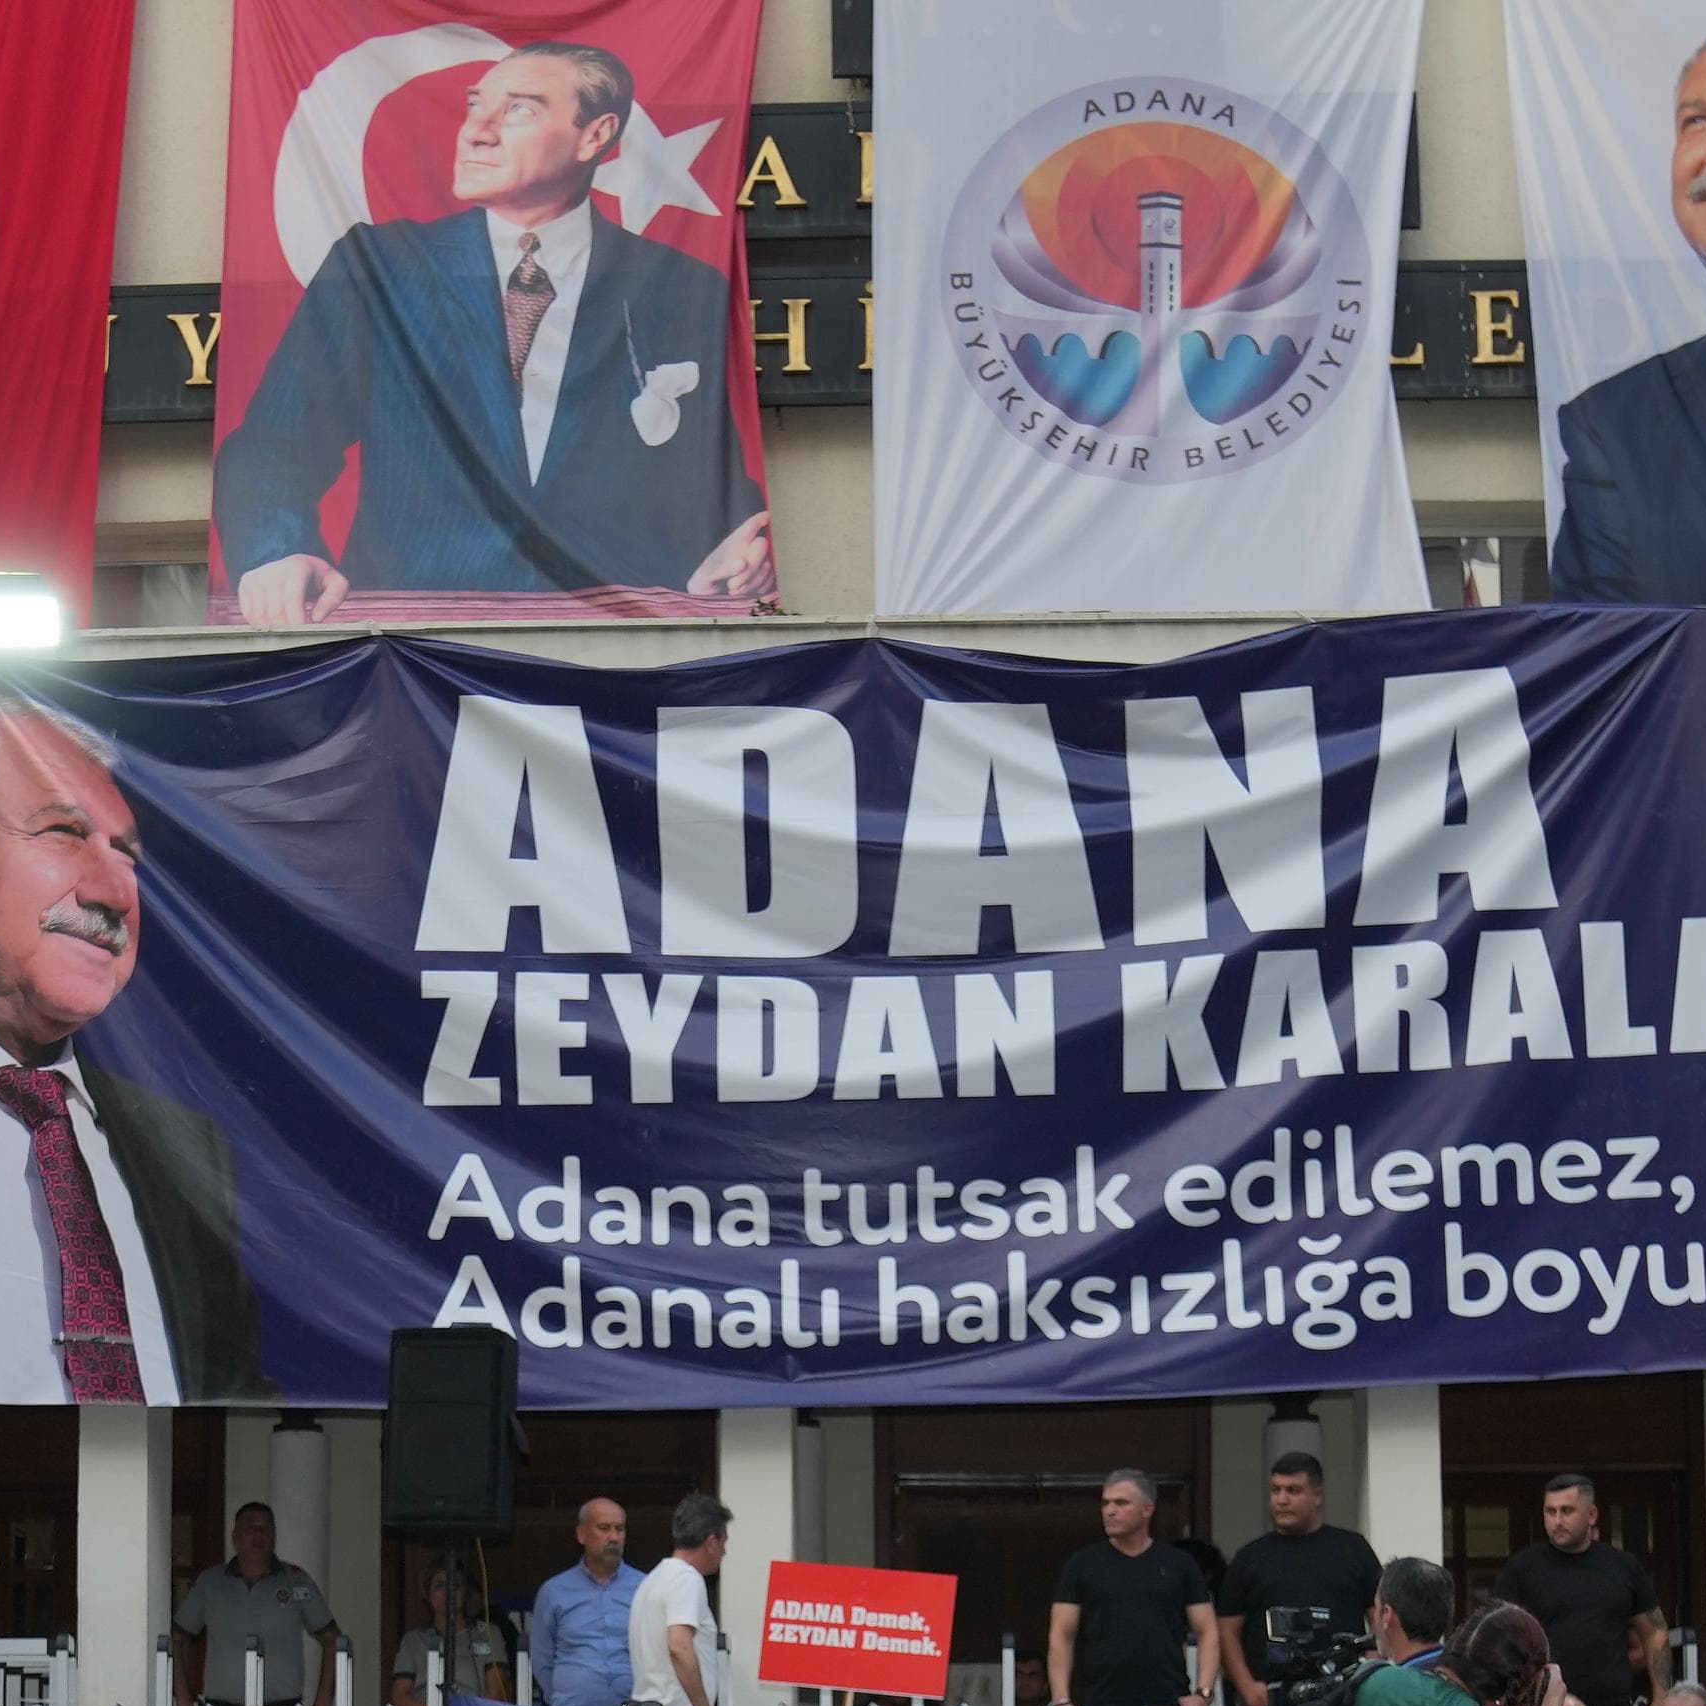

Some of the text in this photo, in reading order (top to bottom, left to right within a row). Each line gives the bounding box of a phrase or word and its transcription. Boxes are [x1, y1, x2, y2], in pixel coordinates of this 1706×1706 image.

[1083, 88, 1237, 127] ADANA
[414, 666, 1560, 958] ADANA
[421, 971, 1063, 1107] ZEYDAN
[428, 1124, 1694, 1248] Adana tutsak edilemez,
[432, 1254, 840, 1349] Adanalı
[878, 1235, 1413, 1350] haksızlığa
[768, 1623, 942, 1657] ZEYDAN Demek.
[771, 1600, 931, 1633] ADANA Demek,
